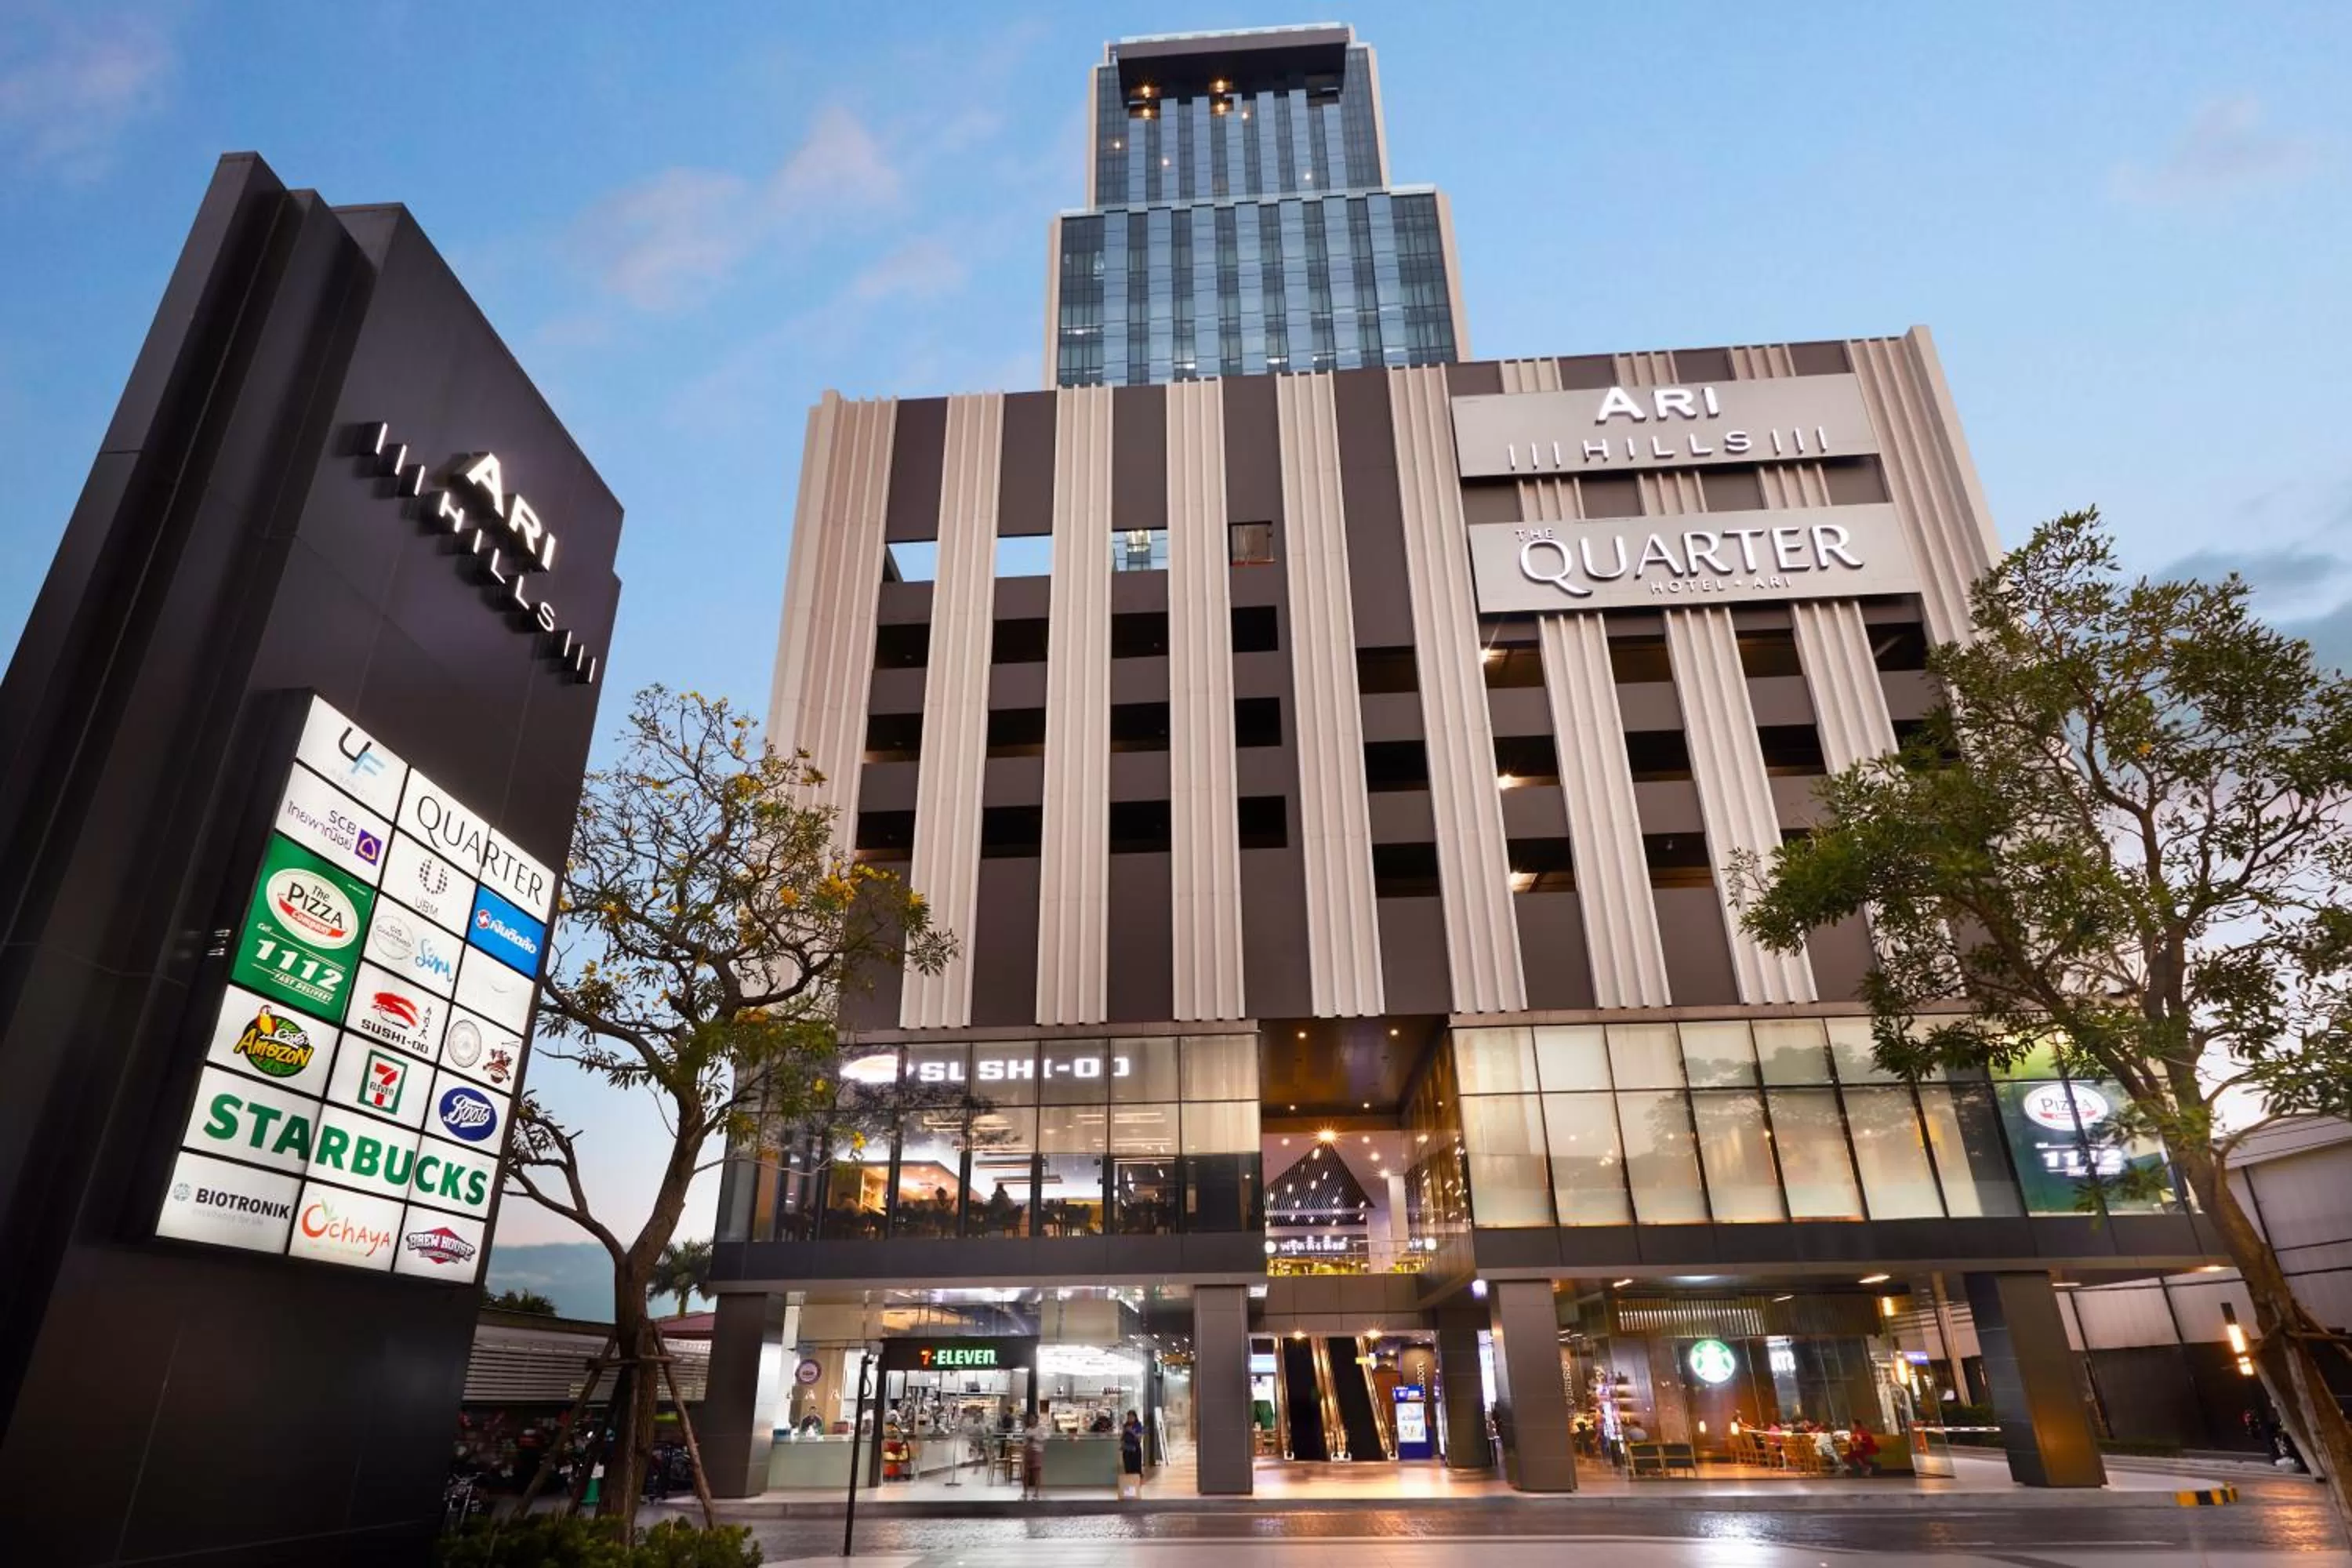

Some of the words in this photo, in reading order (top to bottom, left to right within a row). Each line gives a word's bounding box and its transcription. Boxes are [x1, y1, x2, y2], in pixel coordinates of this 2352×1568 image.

[1595, 387, 1719, 425] ARI
[1582, 430, 1752, 463] HILLS
[466, 452, 557, 571] ARI
[1515, 528, 1555, 543] THE
[438, 491, 556, 632] HILLS
[1519, 524, 1864, 597] QUARTER
[1650, 580, 1725, 595] HOTEL
[1752, 576, 1794, 590] ARI
[329, 810, 357, 836] SCB
[416, 795, 544, 906] QUARTER
[287, 881, 343, 929] PIZZA
[313, 885, 330, 902] The
[256, 938, 344, 993] 1112
[443, 1094, 492, 1128] Boots
[203, 1094, 487, 1206] STARBUCKS
[195, 1188, 291, 1219] BIOTRONIK
